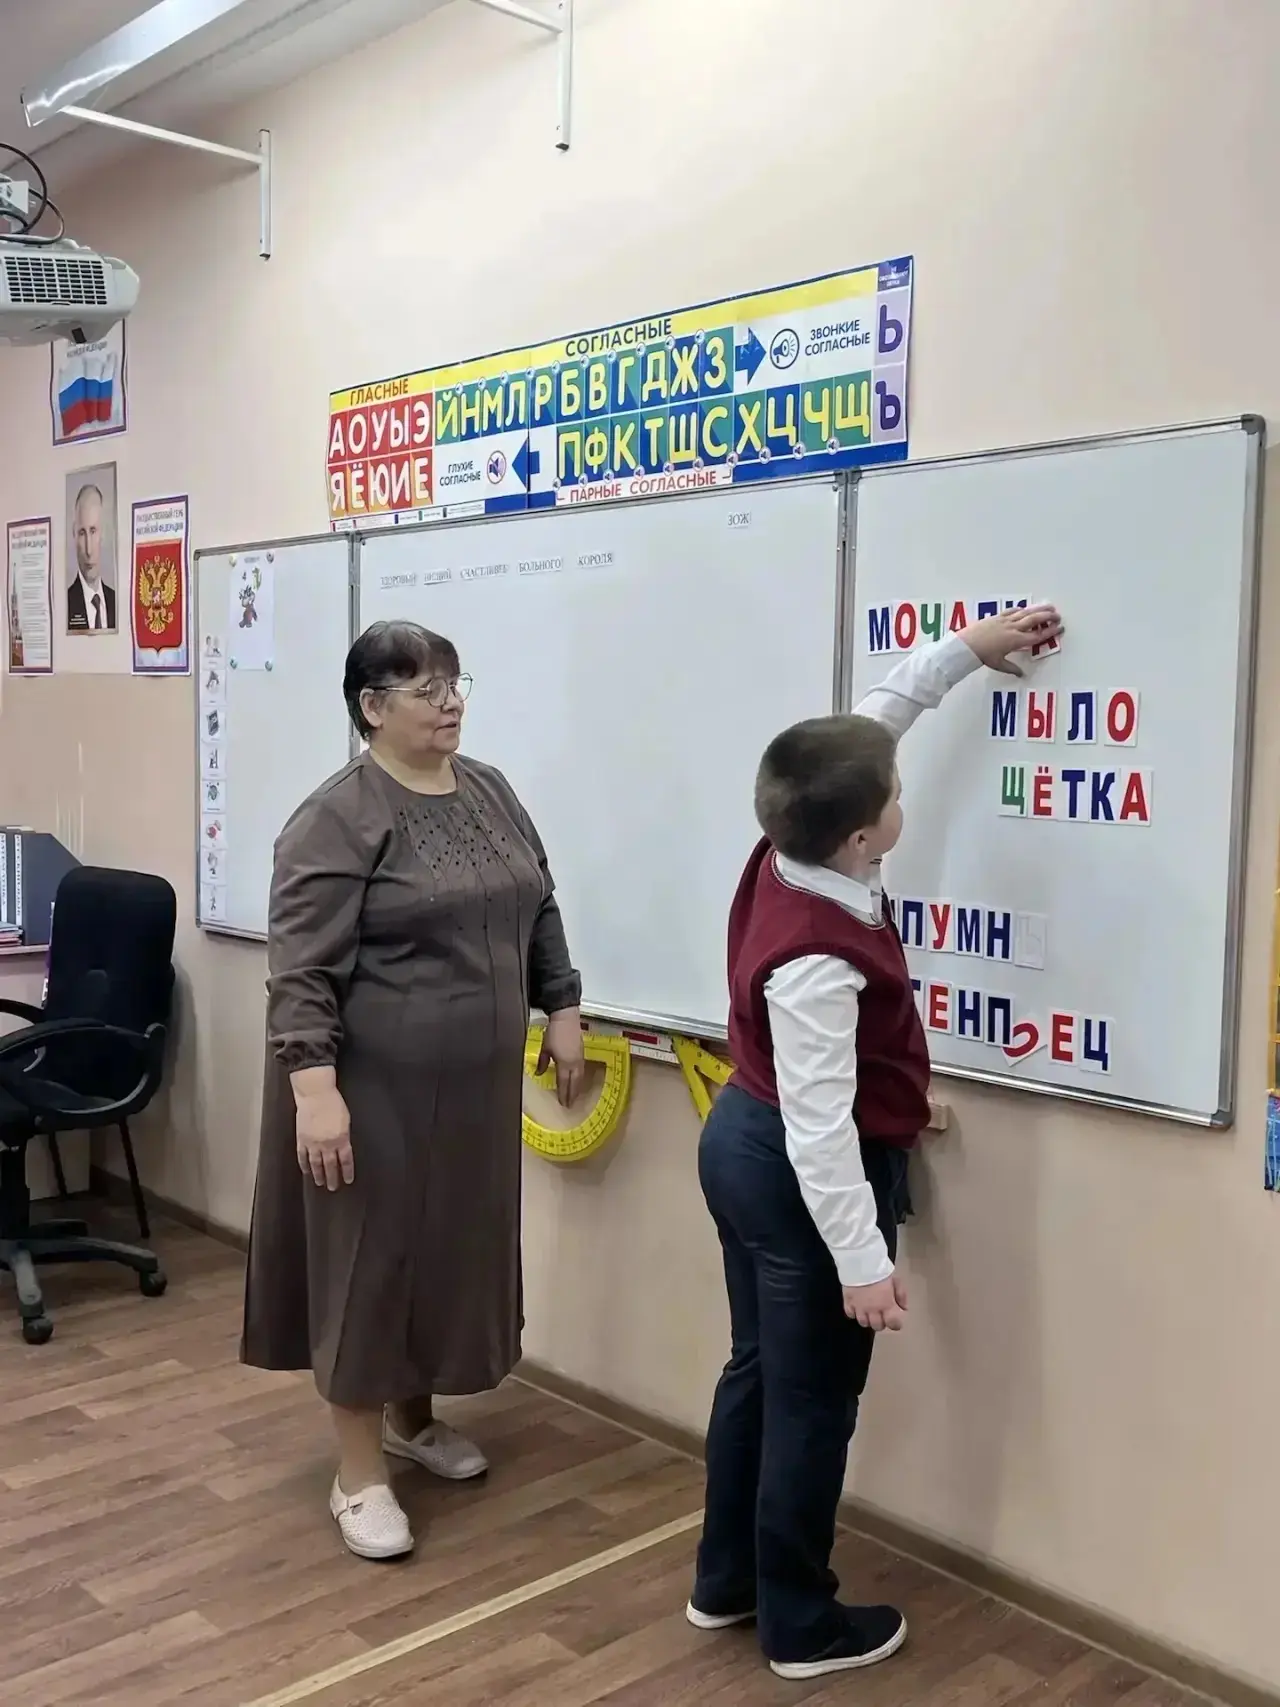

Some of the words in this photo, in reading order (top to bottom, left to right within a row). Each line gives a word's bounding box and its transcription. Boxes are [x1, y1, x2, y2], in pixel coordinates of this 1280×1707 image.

[565, 318, 672, 357] СОГЛАСНЫЕ
[810, 319, 860, 341] ЗВОНКИЕ
[805, 332, 871, 357] СОГЛАСНЫЕ
[350, 379, 409, 406] ГЛАСНЫЕ
[439, 470, 482, 487] СОГЛАСНЫЕ
[448, 460, 474, 474] ГЛУХИЕ
[570, 484, 622, 503] ПАРНЫЕ
[629, 470, 717, 495] СОГЛАСНЫЕ
[519, 558, 561, 573] БОЛЬНОГО
[578, 552, 613, 567] КОРОЛЯ
[992, 690, 1136, 743] МЫЛО
[1002, 766, 1149, 822] ЩЁТКА
